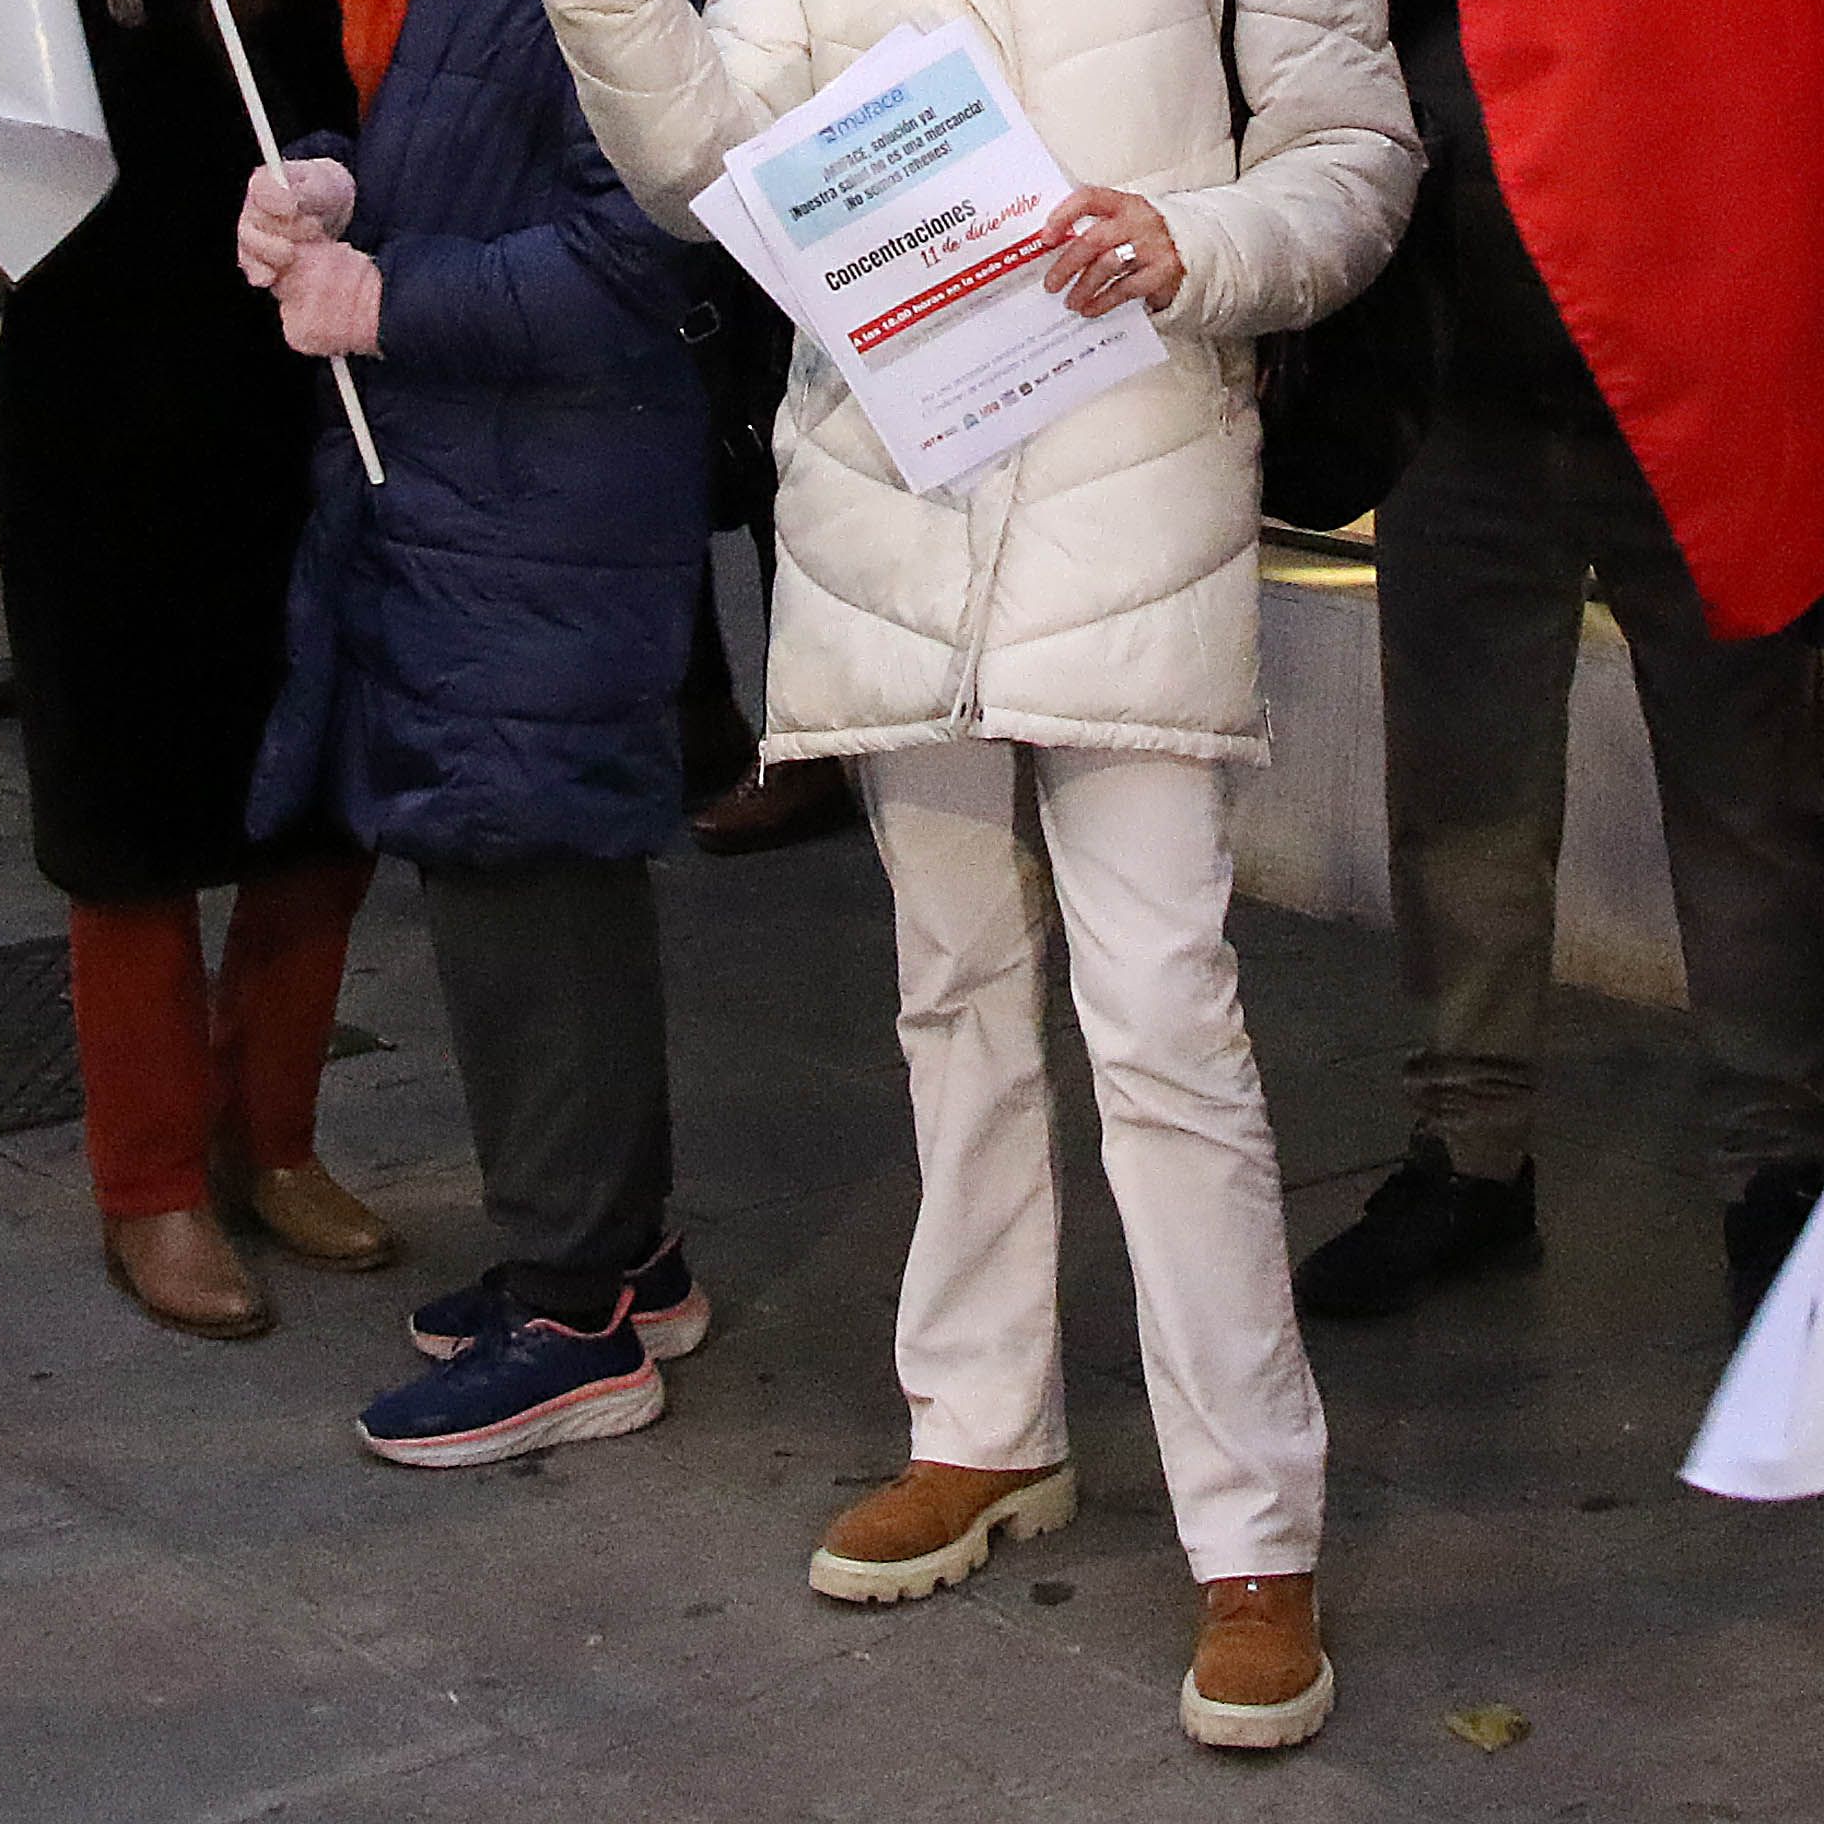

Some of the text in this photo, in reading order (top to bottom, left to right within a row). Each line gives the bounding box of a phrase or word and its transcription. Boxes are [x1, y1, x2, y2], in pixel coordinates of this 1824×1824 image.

[823, 196, 976, 292] Concentraciones
[919, 187, 1044, 268] 11 de diciembre
[911, 289, 945, 313] horas
